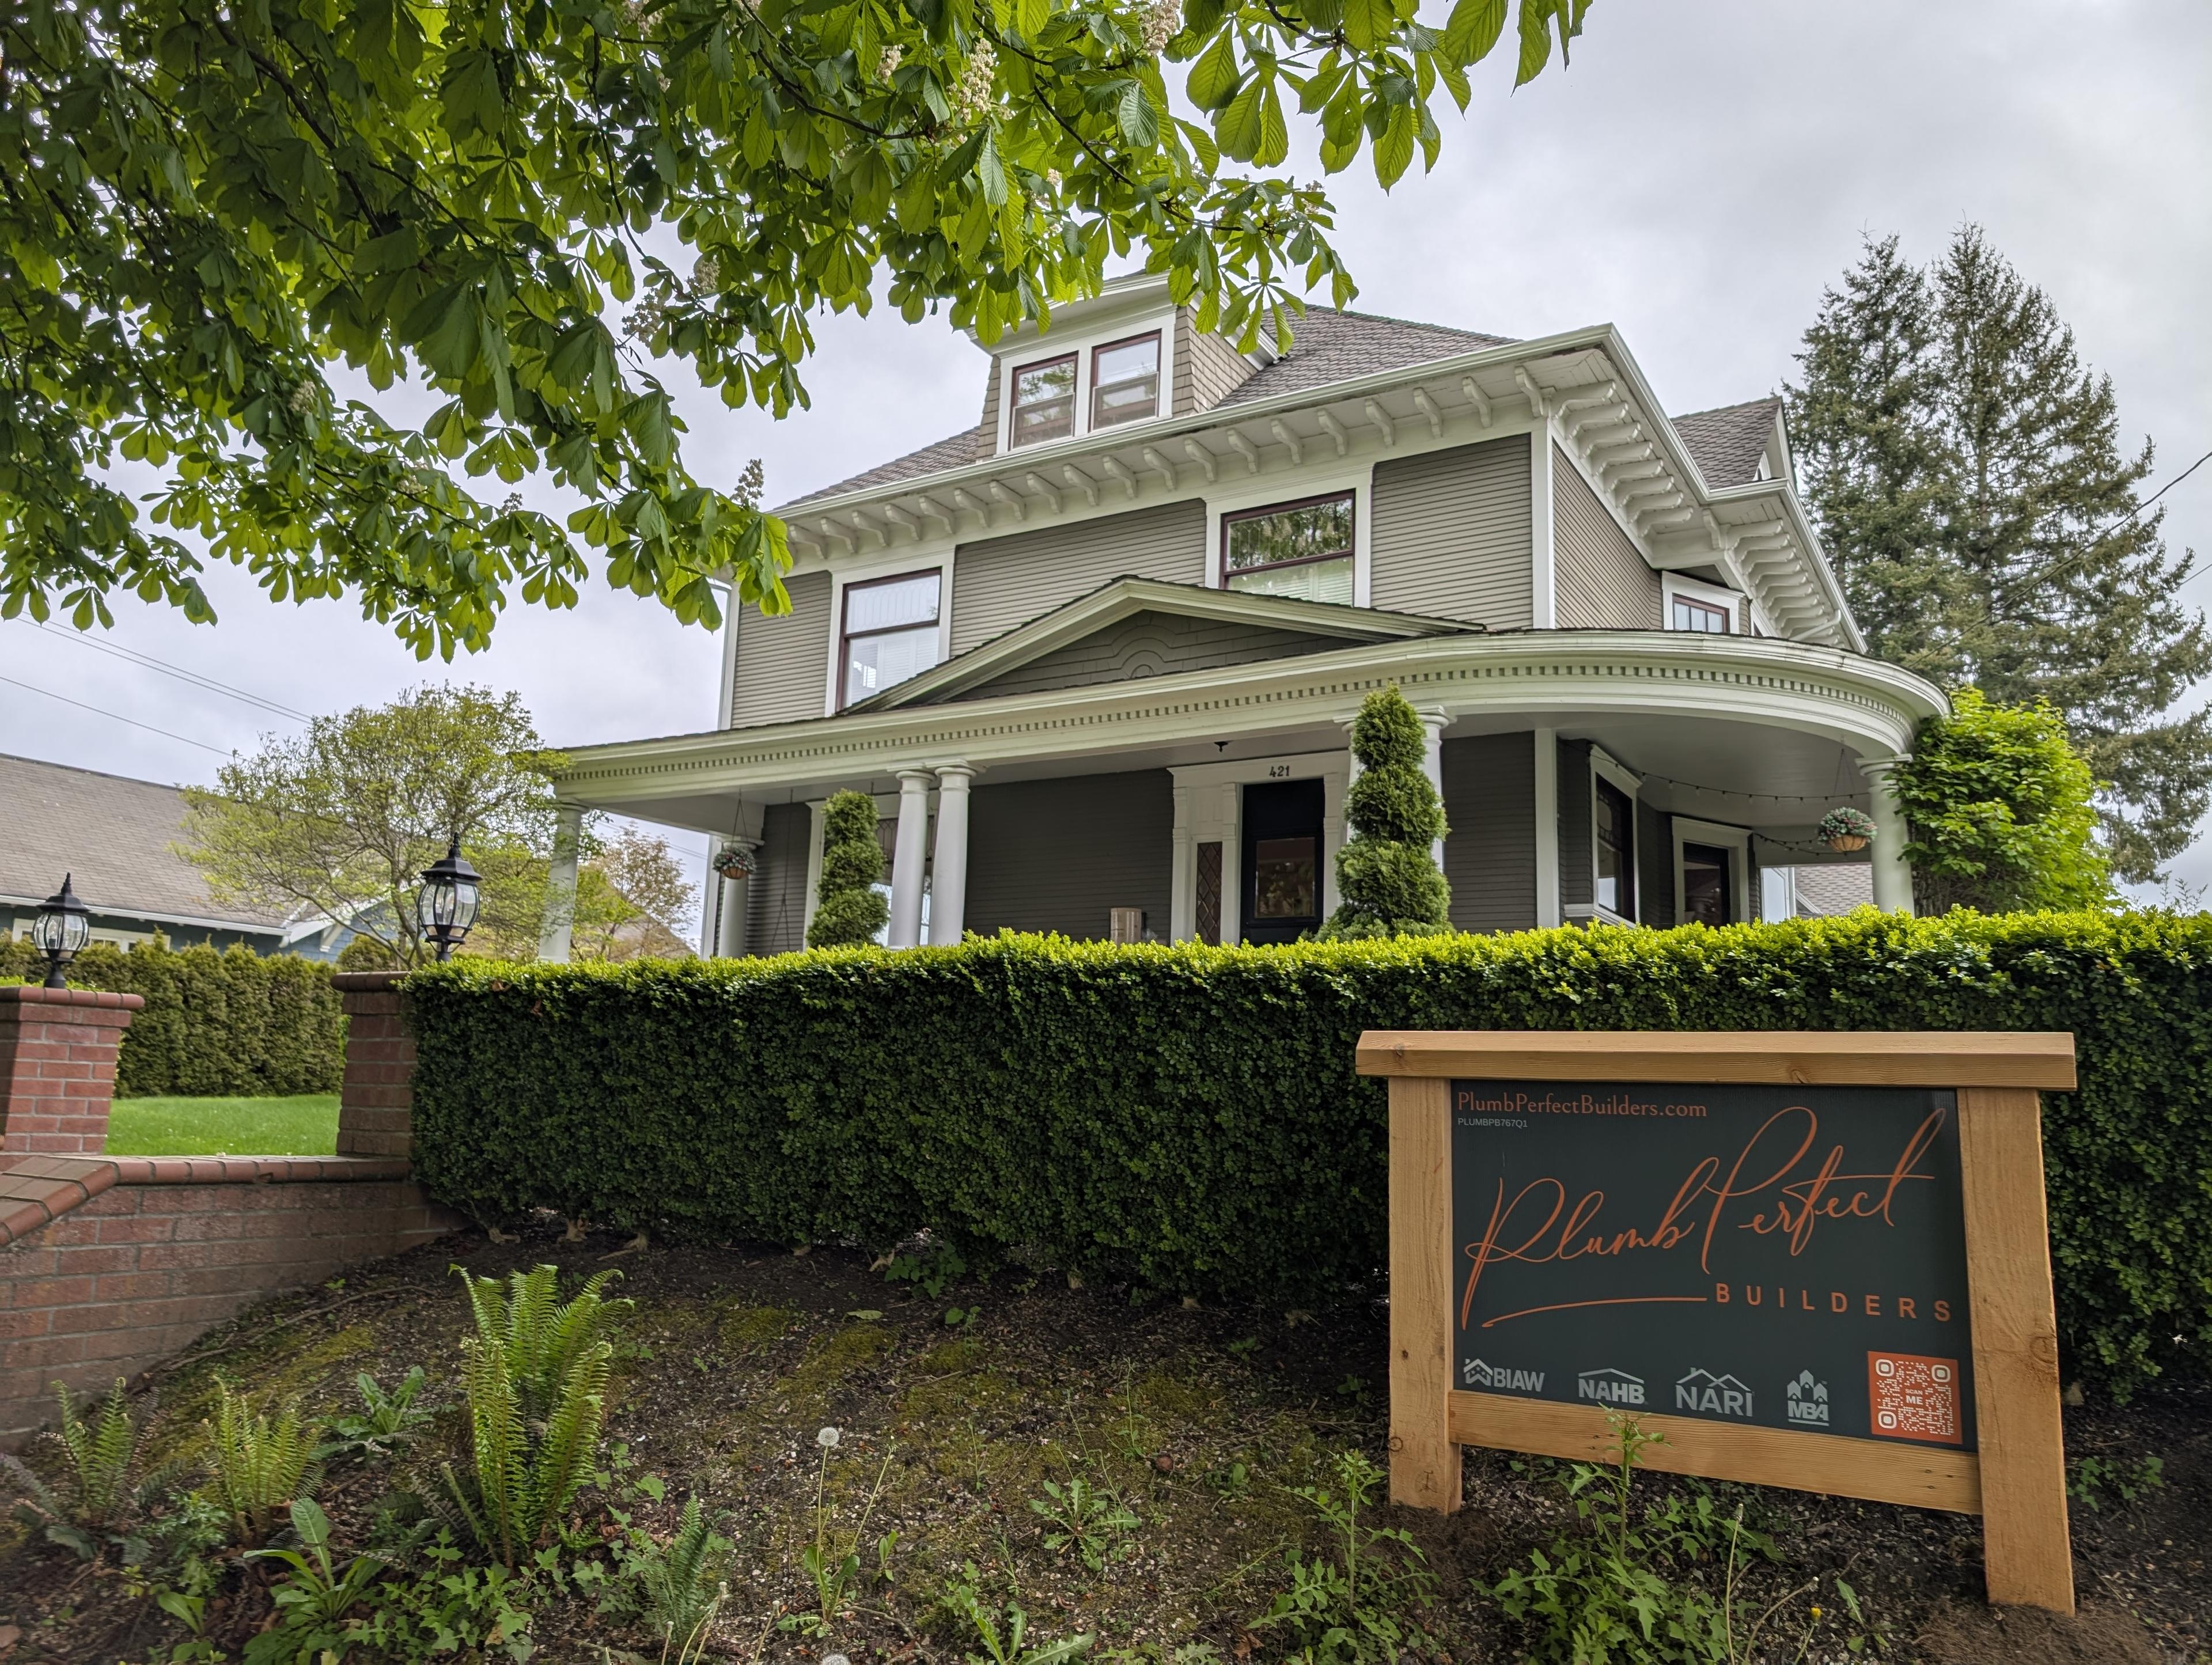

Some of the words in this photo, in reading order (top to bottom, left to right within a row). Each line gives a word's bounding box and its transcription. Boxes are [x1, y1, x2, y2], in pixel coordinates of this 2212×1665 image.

[1269, 765, 1290, 777] 421
[1457, 1092, 1707, 1117] PlumbPerfectBuilders.com
[1457, 1117, 1528, 1128] PLUMBPB767Q1
[1462, 1156, 1719, 1330] Plumb
[1702, 1106, 1946, 1275] Perfect
[1716, 1283, 1952, 1322] BUILDERS
[1494, 1367, 1545, 1392] BIAW
[1578, 1379, 1645, 1404] NAHB
[1675, 1385, 1753, 1417] NARI
[1787, 1400, 1830, 1421] MBA
[1906, 1395, 1923, 1405] ME
